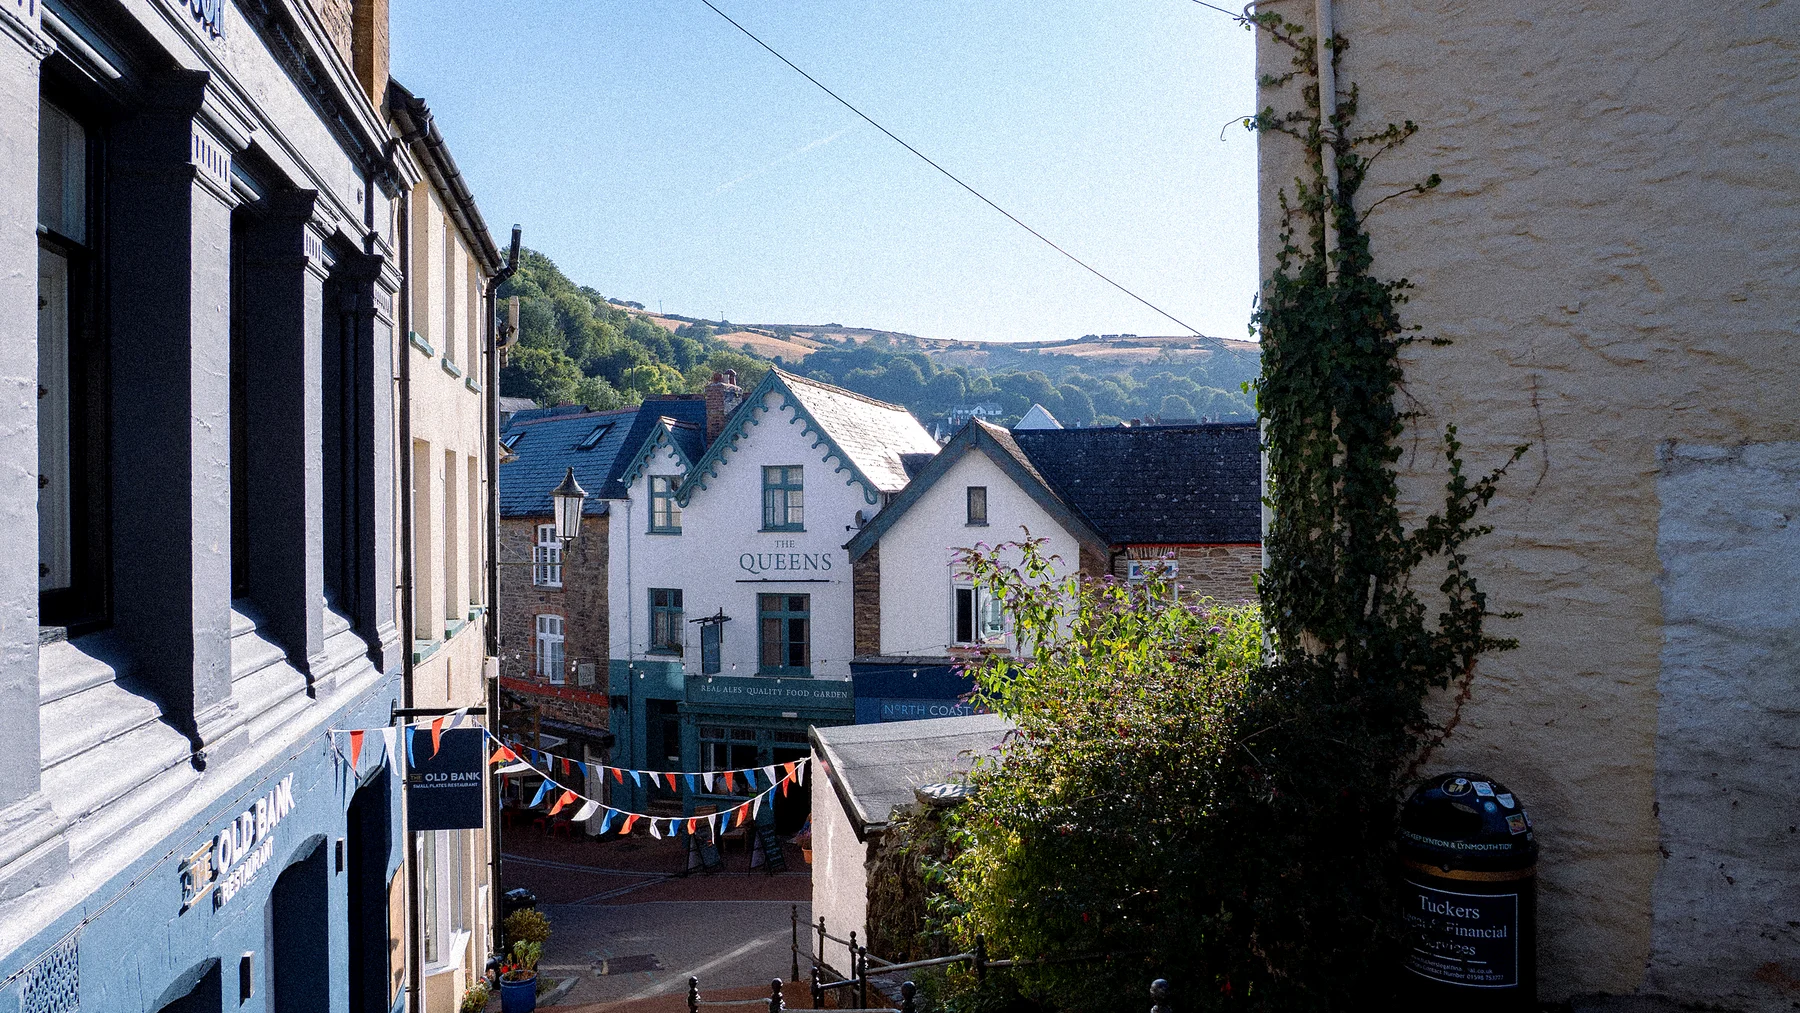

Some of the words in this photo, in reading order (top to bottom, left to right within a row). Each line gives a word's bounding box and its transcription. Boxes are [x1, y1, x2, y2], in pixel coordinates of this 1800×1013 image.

[775, 540, 795, 548] THE
[740, 553, 832, 574] QUEENS
[723, 686, 742, 694] ALES
[747, 687, 782, 697] QUALITY
[786, 689, 809, 697] FOOD
[813, 690, 848, 698] GARDEN
[929, 705, 971, 716] COAST
[425, 773, 448, 781] OLD
[451, 772, 481, 781] BANK
[218, 810, 254, 875] OLD
[256, 772, 295, 841] BANK
[1423, 836, 1449, 848] LYNTON
[1450, 841, 1456, 849] &
[1457, 842, 1499, 851] LYNMOUTH
[220, 835, 274, 906] RESTAURANT
[1418, 895, 1481, 919] Tuckers
[1446, 921, 1507, 939] Financial
[1443, 970, 1465, 979] Number
